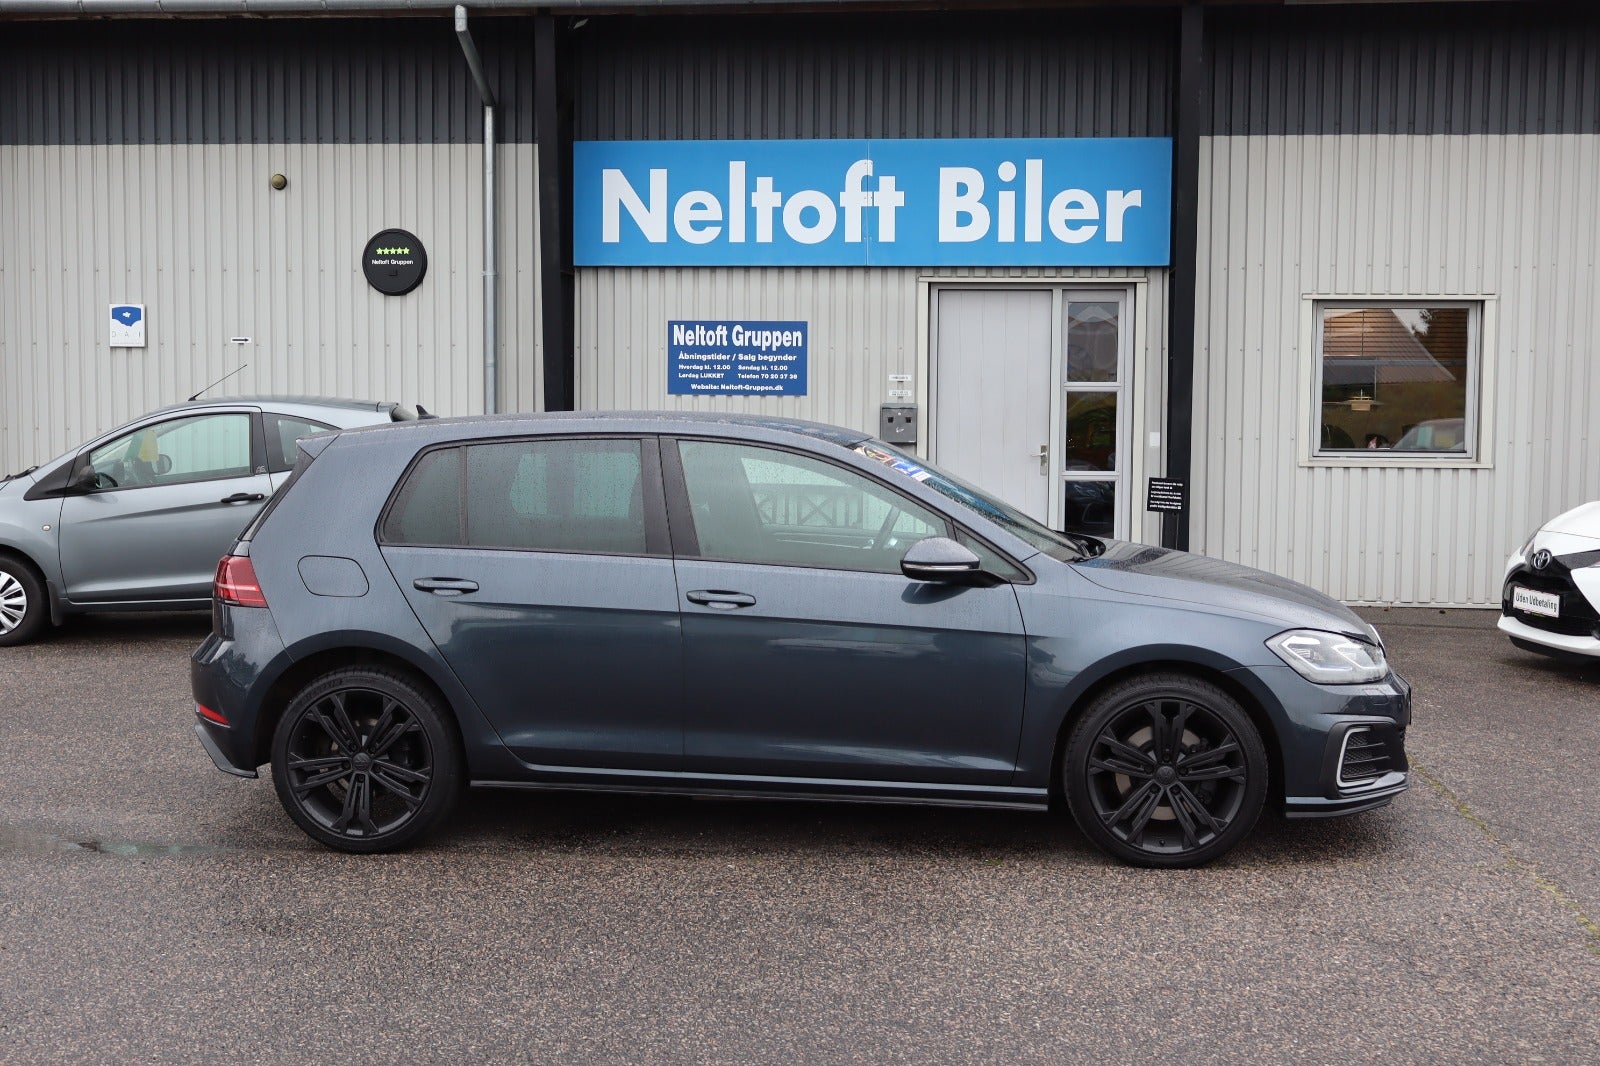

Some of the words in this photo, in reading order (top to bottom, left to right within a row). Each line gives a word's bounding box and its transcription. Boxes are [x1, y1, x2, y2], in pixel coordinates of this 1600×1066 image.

[601, 159, 904, 245] Neltoft
[938, 158, 1142, 244] Biler
[673, 324, 728, 347] Neltoft
[731, 324, 803, 352] Gruppen
[678, 350, 731, 362] Åbningstider
[731, 353, 737, 362] /
[738, 353, 756, 362] Salg
[757, 354, 797, 362] begynder
[690, 383, 720, 391] Website:
[720, 383, 784, 392] Neltoft-Gruppen.dk
[1516, 592, 1528, 603] Uden
